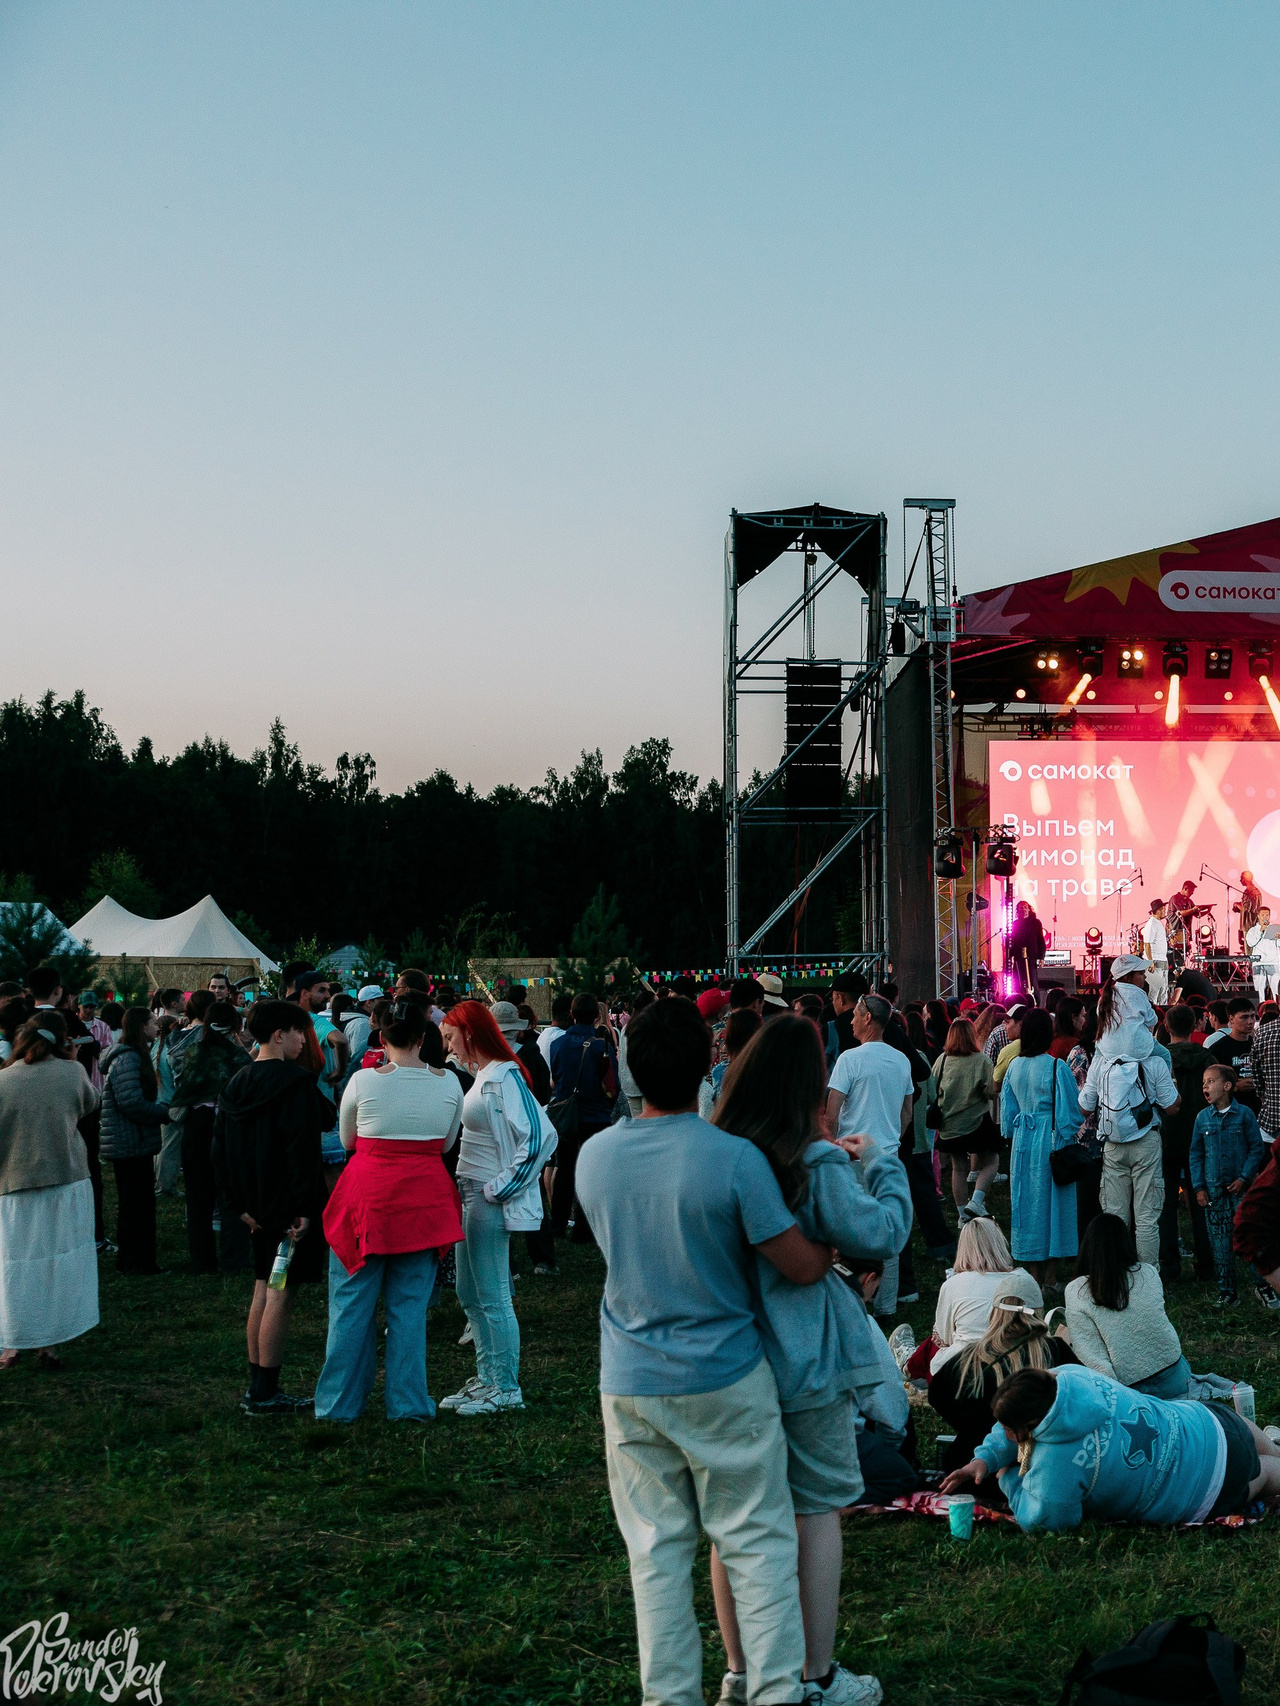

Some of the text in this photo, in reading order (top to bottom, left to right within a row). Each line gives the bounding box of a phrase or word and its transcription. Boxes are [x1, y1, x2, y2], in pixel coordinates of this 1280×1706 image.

[1027, 763, 1134, 780] самокат
[1003, 813, 1114, 837] Выпьем
[1014, 849, 1135, 869] имонад
[1047, 877, 1133, 902] траве
